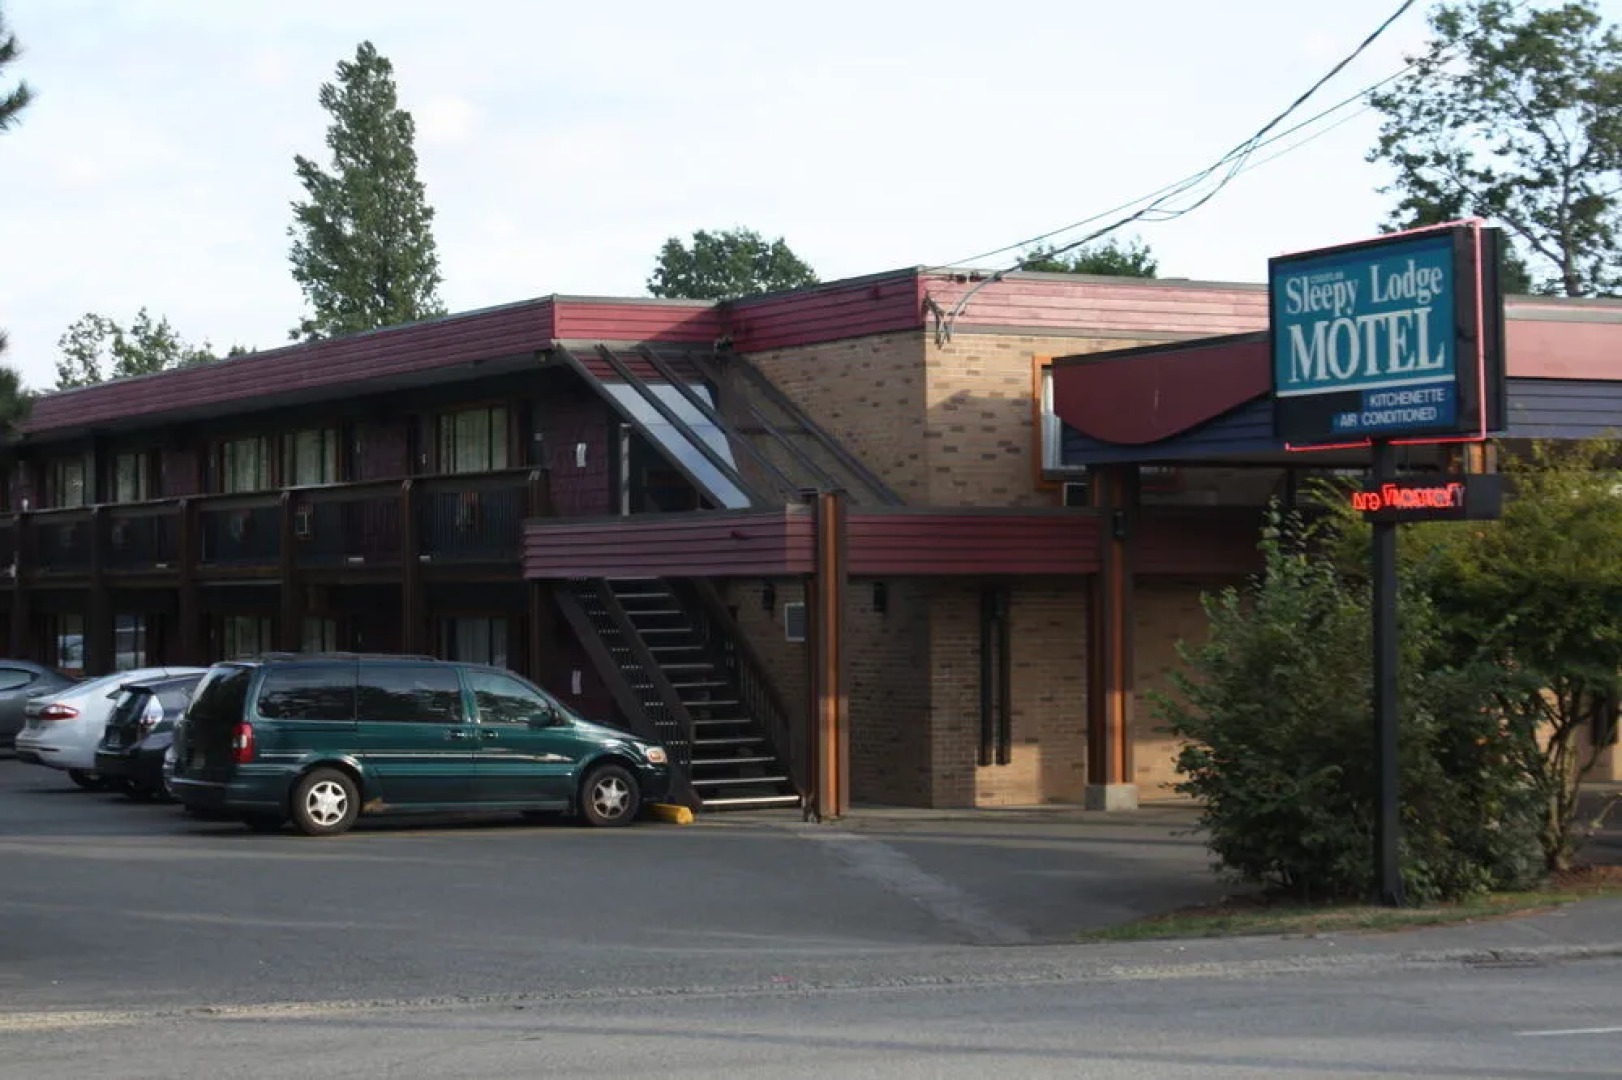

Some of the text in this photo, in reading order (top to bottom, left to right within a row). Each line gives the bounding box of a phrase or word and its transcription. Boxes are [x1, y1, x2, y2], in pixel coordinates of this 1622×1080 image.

[1286, 259, 1443, 317] Sleepy Lodge
[1288, 307, 1445, 383] MOTEL
[1340, 406, 1437, 428] AIR CONDITIONED
[1370, 388, 1445, 407] KITCHENETTE
